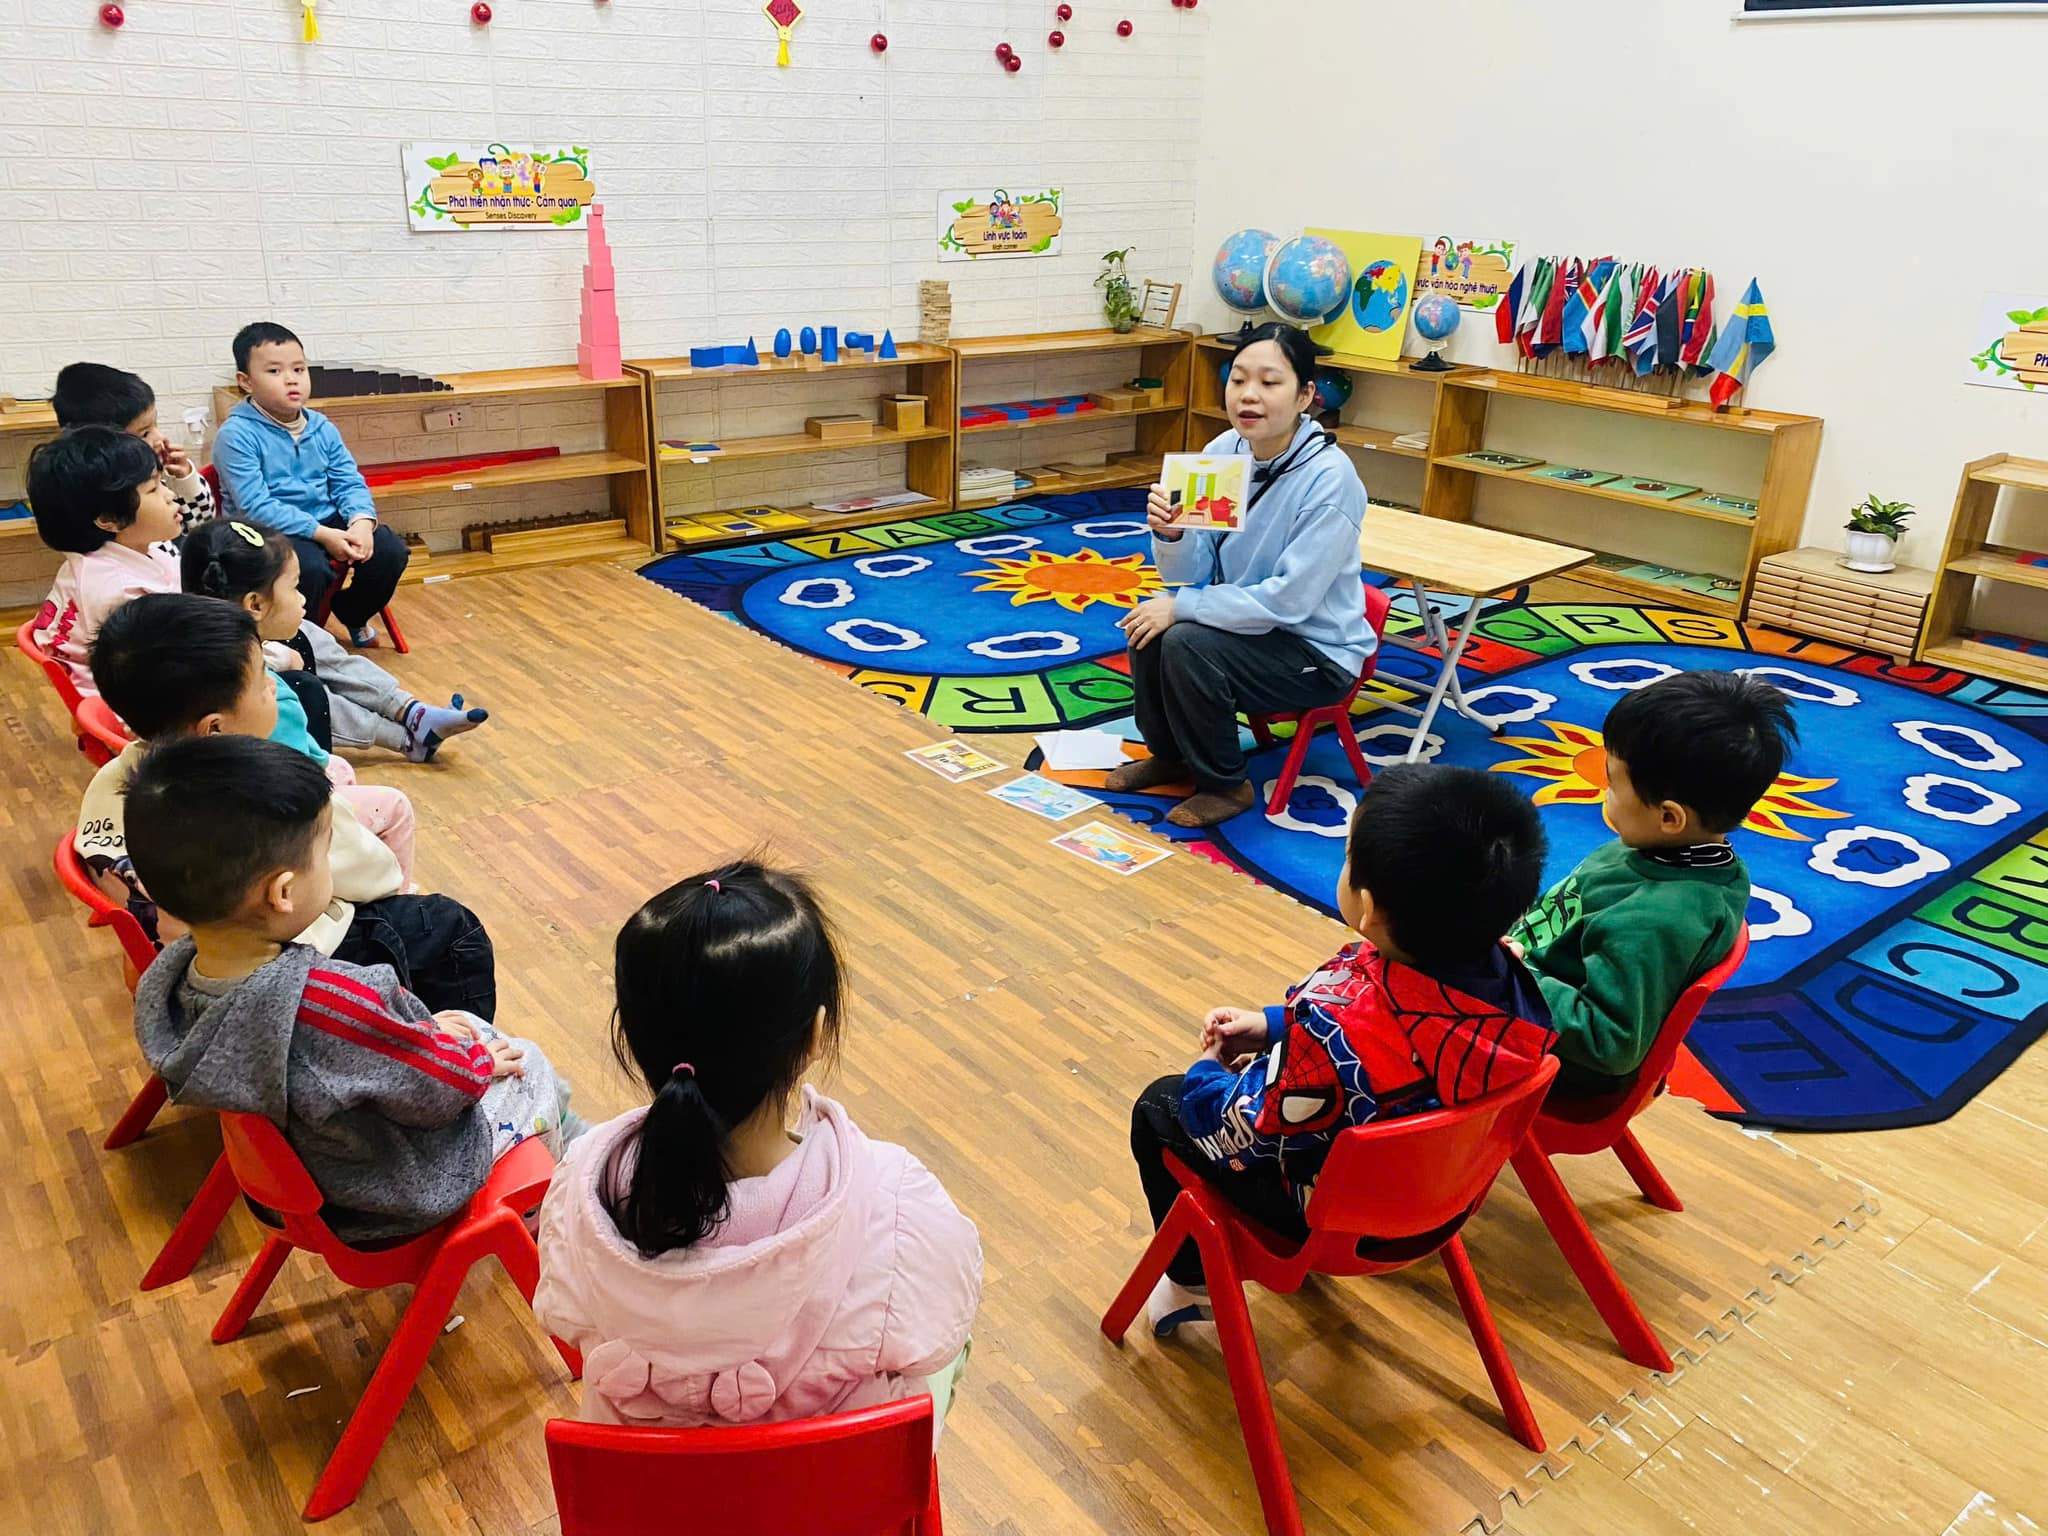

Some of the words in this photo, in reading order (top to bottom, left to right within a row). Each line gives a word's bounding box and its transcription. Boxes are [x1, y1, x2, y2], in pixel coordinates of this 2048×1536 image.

[485, 212, 507, 220] Senses
[508, 211, 537, 221] Discovery
[558, 197, 578, 210] quan
[728, 547, 792, 563] Y
[804, 537, 871, 554] Z
[884, 528, 941, 544] A
[937, 518, 995, 533] B
[1000, 507, 1053, 521] C
[1476, 619, 1561, 642] Q
[1562, 613, 1652, 635] R
[1667, 618, 1728, 641] S
[953, 687, 1027, 714] R
[1056, 677, 1135, 704] Q
[1886, 942, 2021, 999] C
[1835, 974, 1984, 1044] D
[1698, 1010, 1848, 1082] E
